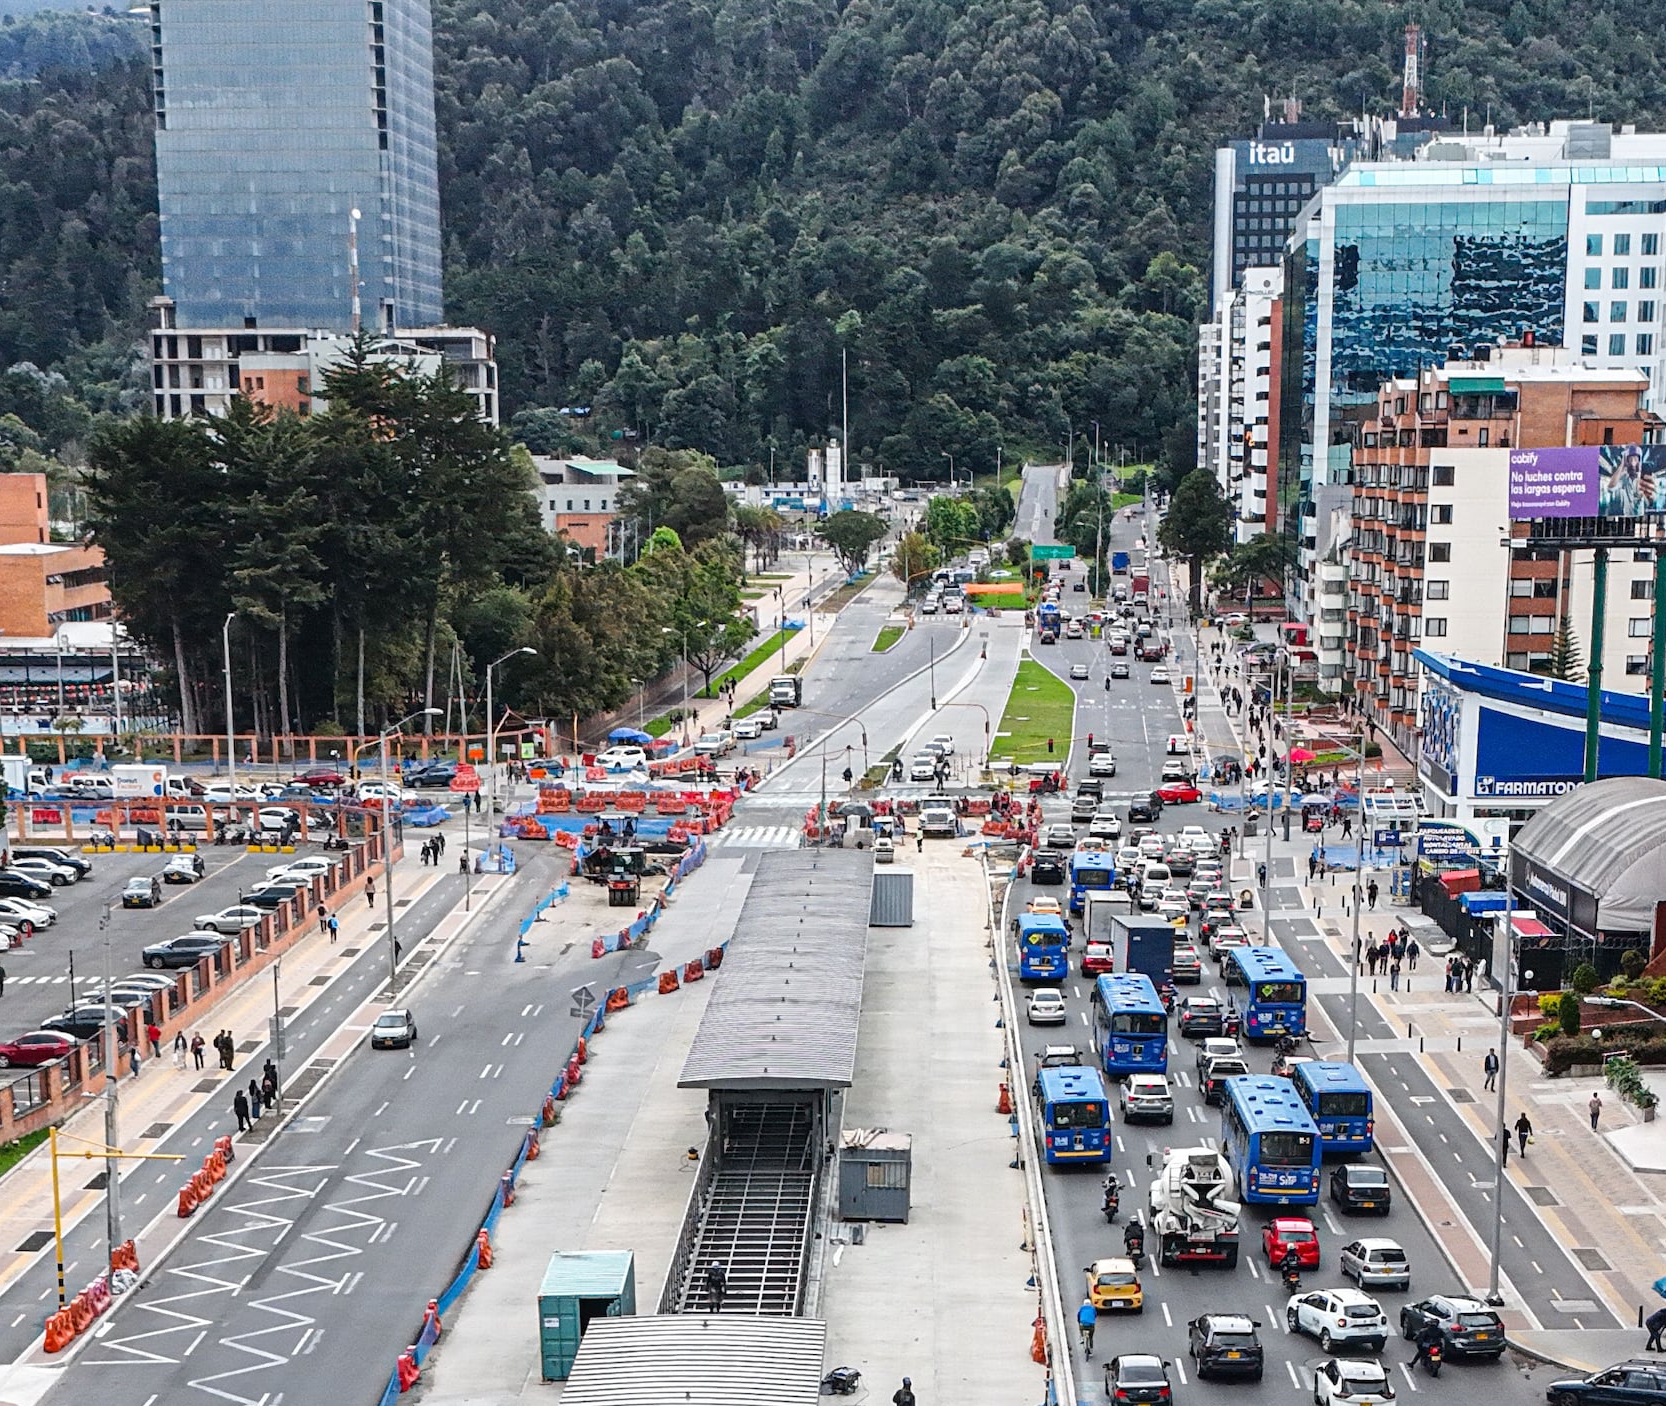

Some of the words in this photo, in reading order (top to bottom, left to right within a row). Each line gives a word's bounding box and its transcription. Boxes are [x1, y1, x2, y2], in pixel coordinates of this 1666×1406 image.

[1249, 141, 1295, 164] itaú
[1511, 472, 1523, 482] No
[1525, 471, 1552, 482] luches
[1554, 472, 1583, 481] contra
[1511, 483, 1523, 494] las
[1524, 483, 1551, 496] largas
[1552, 484, 1586, 495] esperas
